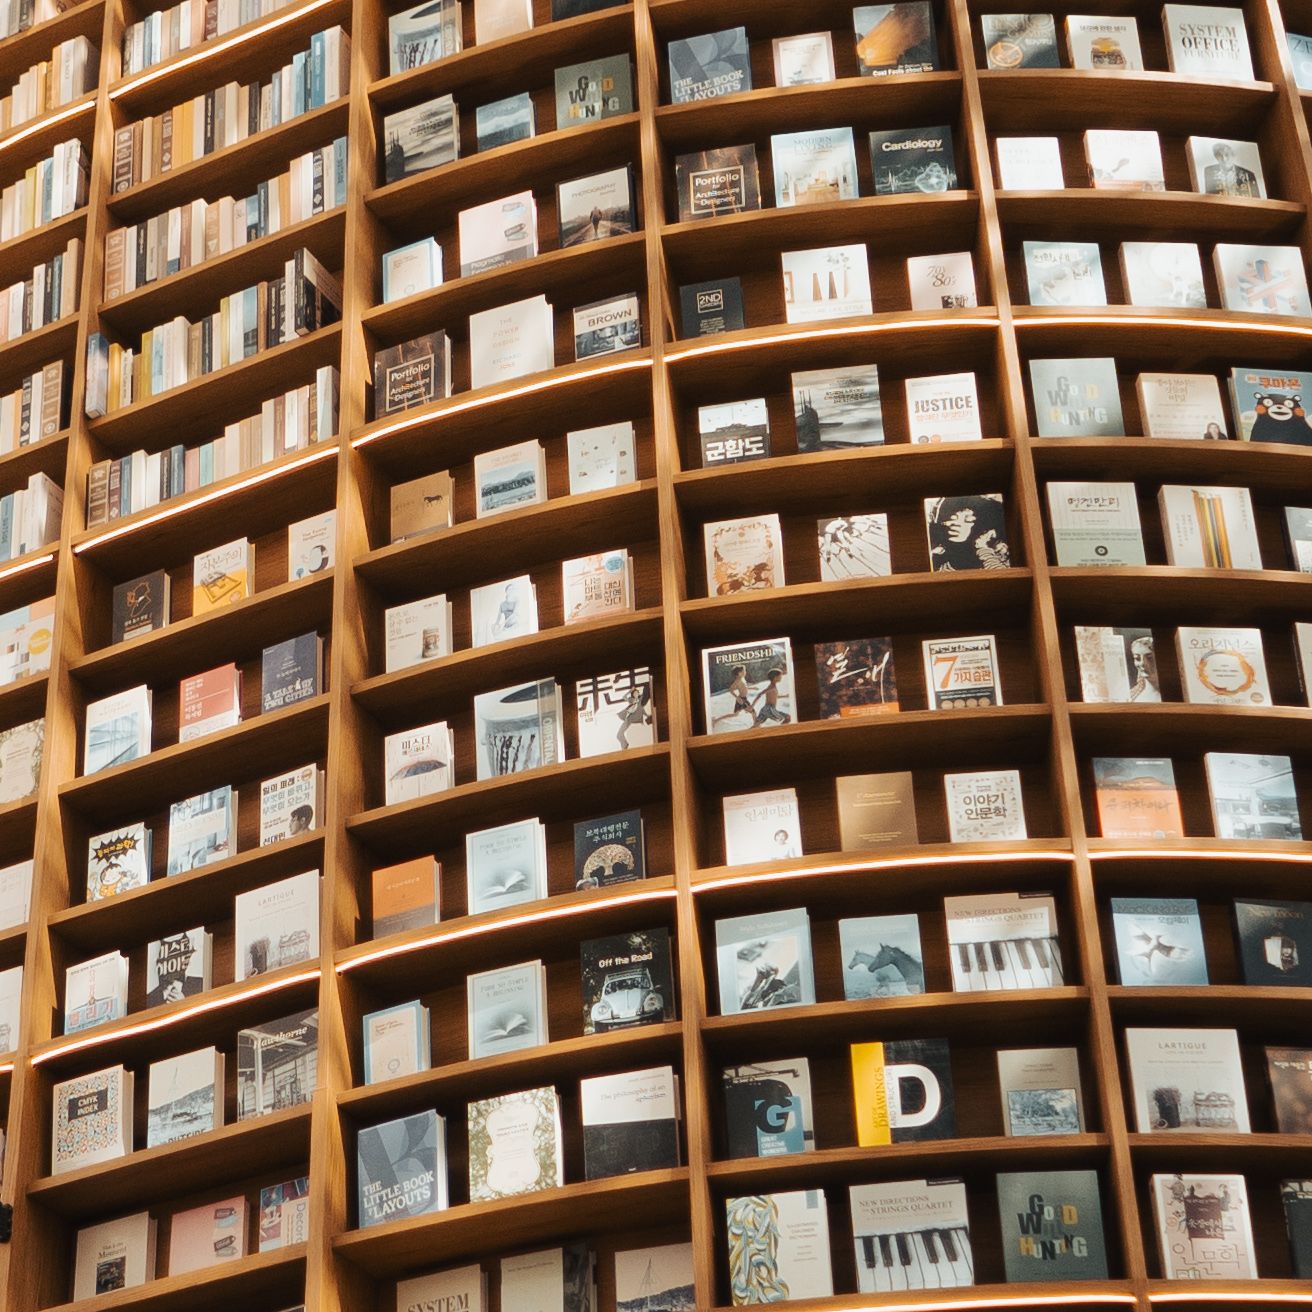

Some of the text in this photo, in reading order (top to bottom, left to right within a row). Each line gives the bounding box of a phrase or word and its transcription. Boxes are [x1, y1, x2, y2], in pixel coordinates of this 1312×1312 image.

[1179, 23, 1236, 38] SYSTEM
[1181, 37, 1239, 51] OFFICE
[674, 77, 693, 88] THE
[674, 69, 744, 98] LITTLE BOOK
[882, 138, 943, 152] Cardiology
[695, 172, 739, 186] Portfolio
[699, 293, 721, 303] 2ND
[588, 309, 632, 327] BROWN
[391, 363, 430, 381] Portfolio
[915, 395, 973, 414] JUSTICE
[706, 436, 765, 462] 군함도
[933, 655, 959, 689] 7
[954, 668, 992, 684] 가지 습관
[263, 777, 295, 795] 일의 미래
[962, 792, 1006, 807] 이야기
[964, 806, 1008, 821] 인문학
[974, 905, 1022, 916] DIRECTIONS
[1003, 910, 1045, 922] QUARTET
[599, 952, 653, 969] Off the Road
[1158, 1042, 1207, 1050] LARTIGUE
[78, 1096, 98, 1107] CMYK
[876, 1067, 890, 1128] DRAWINGS
[886, 1063, 940, 1129] D
[363, 1181, 382, 1196] THE
[364, 1170, 435, 1208] LITTLE BOOK
[374, 1187, 431, 1219] LAYOUTS
[859, 1195, 930, 1208] NEW DIRECTIONS
[870, 1199, 954, 1215] STRINGS QUARTET
[1019, 1235, 1088, 1261] HUNTING
